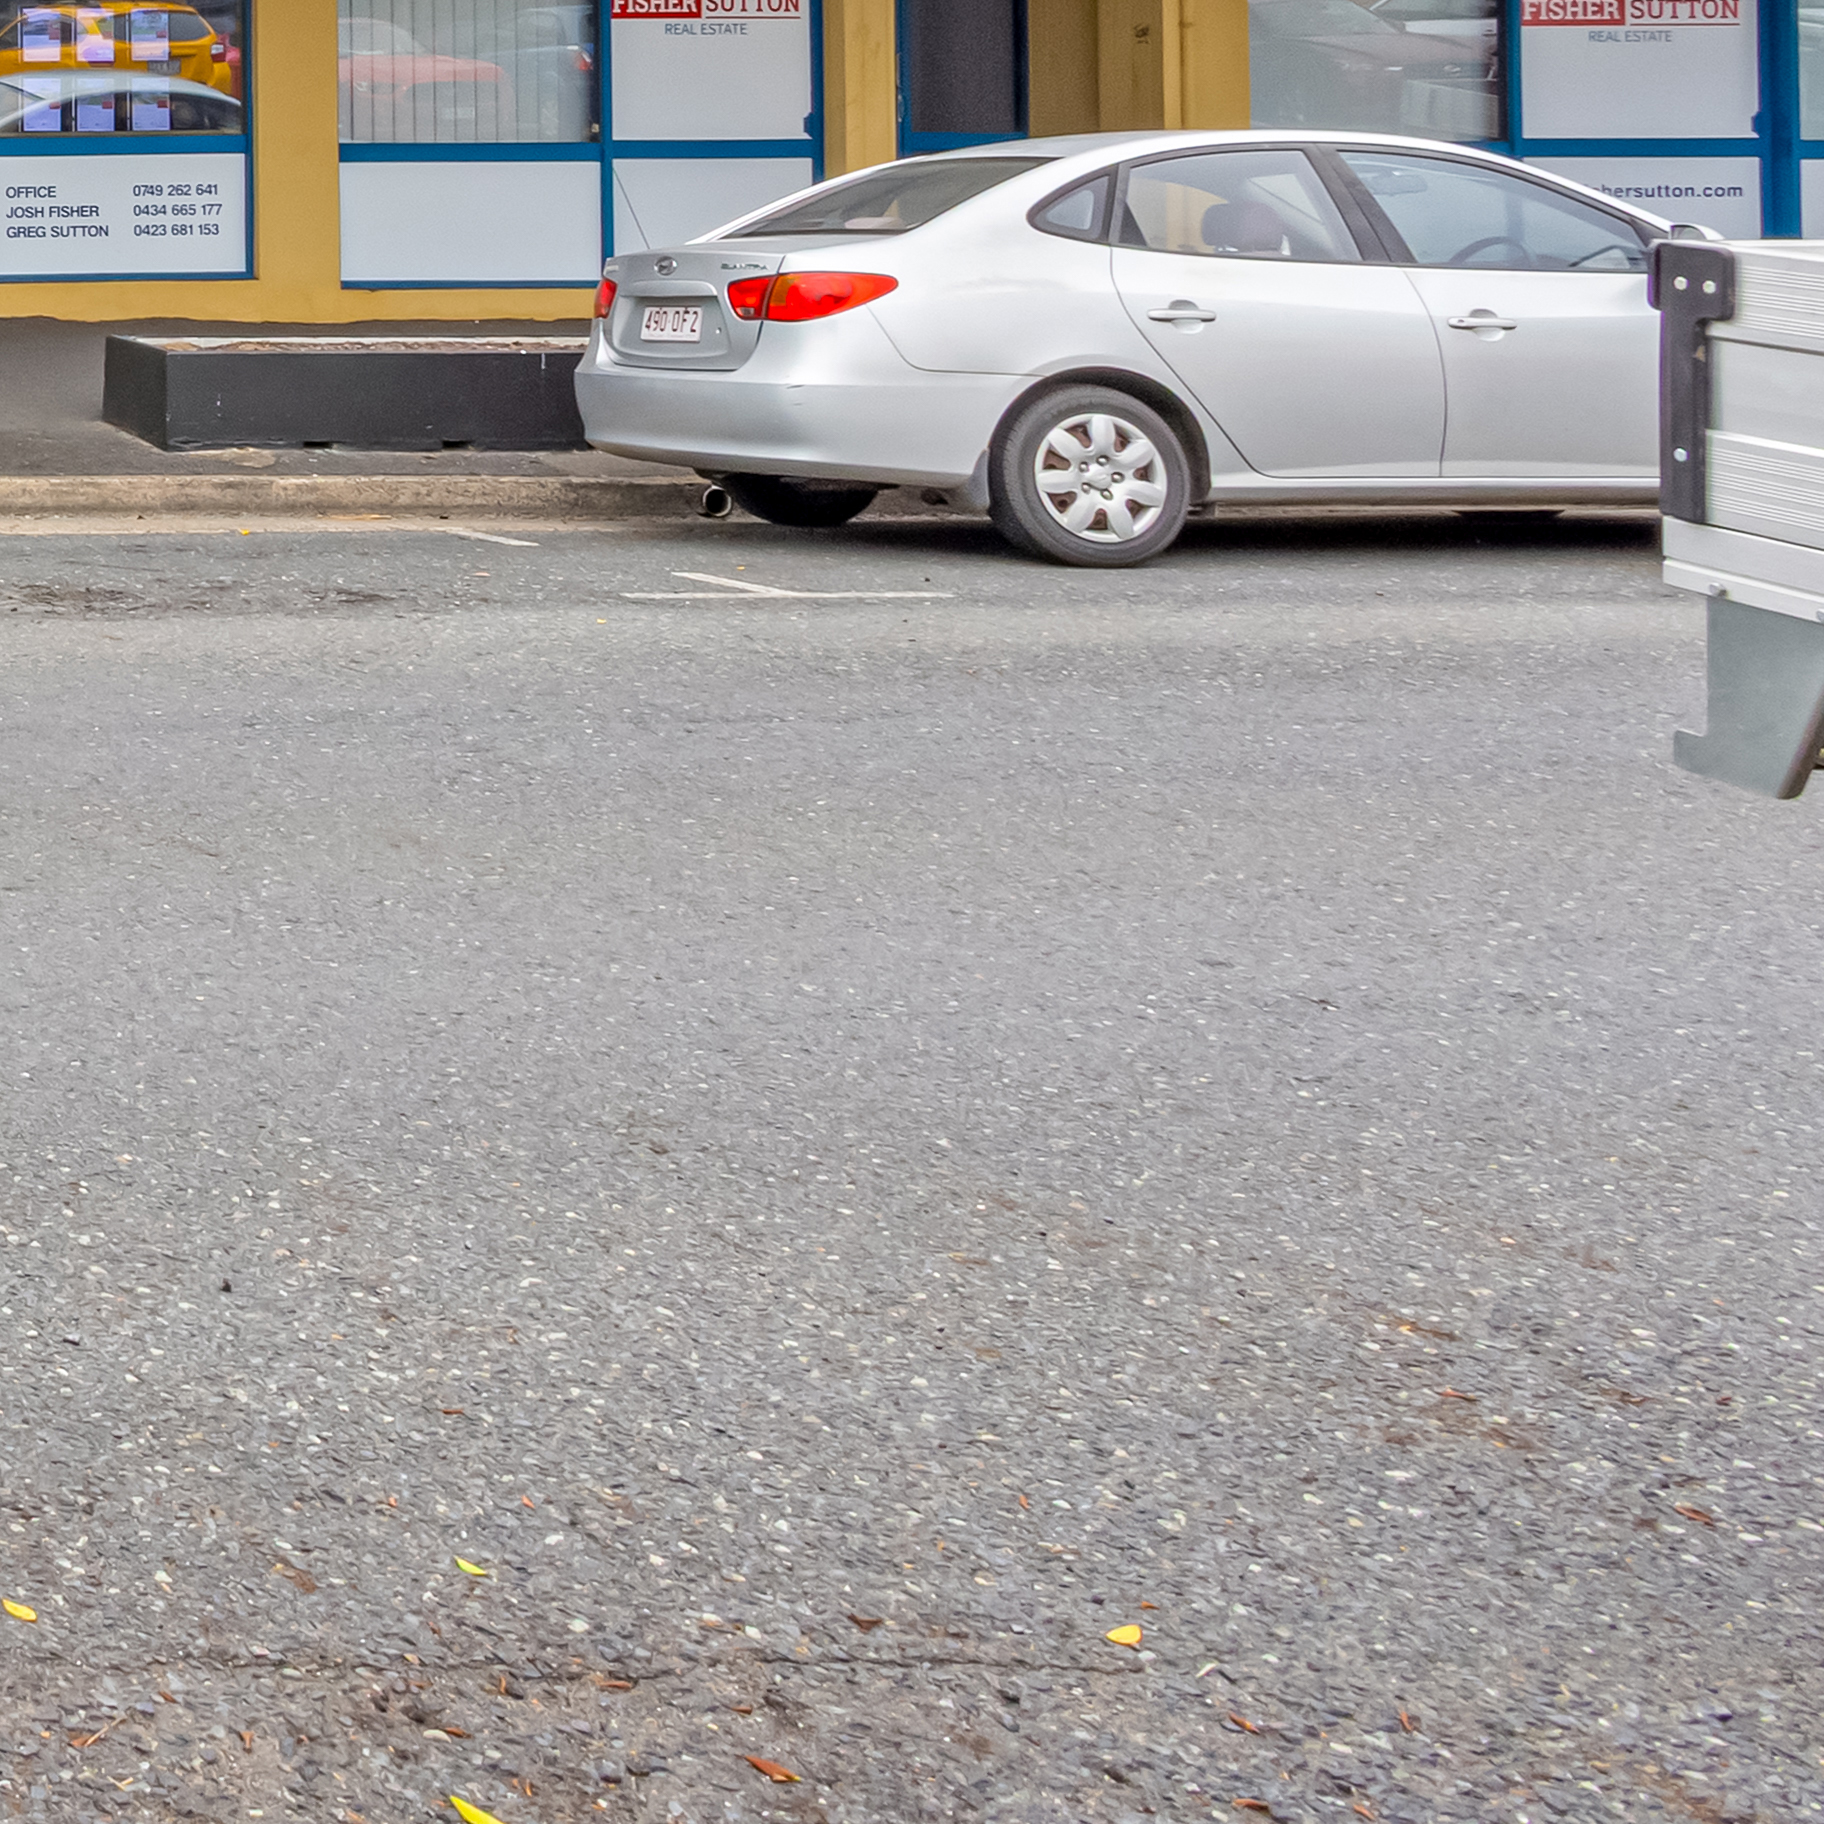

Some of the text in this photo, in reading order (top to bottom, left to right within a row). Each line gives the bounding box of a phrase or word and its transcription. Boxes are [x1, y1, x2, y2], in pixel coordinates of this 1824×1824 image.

[664, 22, 748, 36] REAL ESTATE
[1588, 29, 1673, 43] REAL ESTATE
[5, 183, 218, 199] OFFICE 0749 262 641
[5, 203, 223, 219] JOSH FISHER 0434 665 177
[5, 223, 220, 239] GREG SUTTON 0423 681 153
